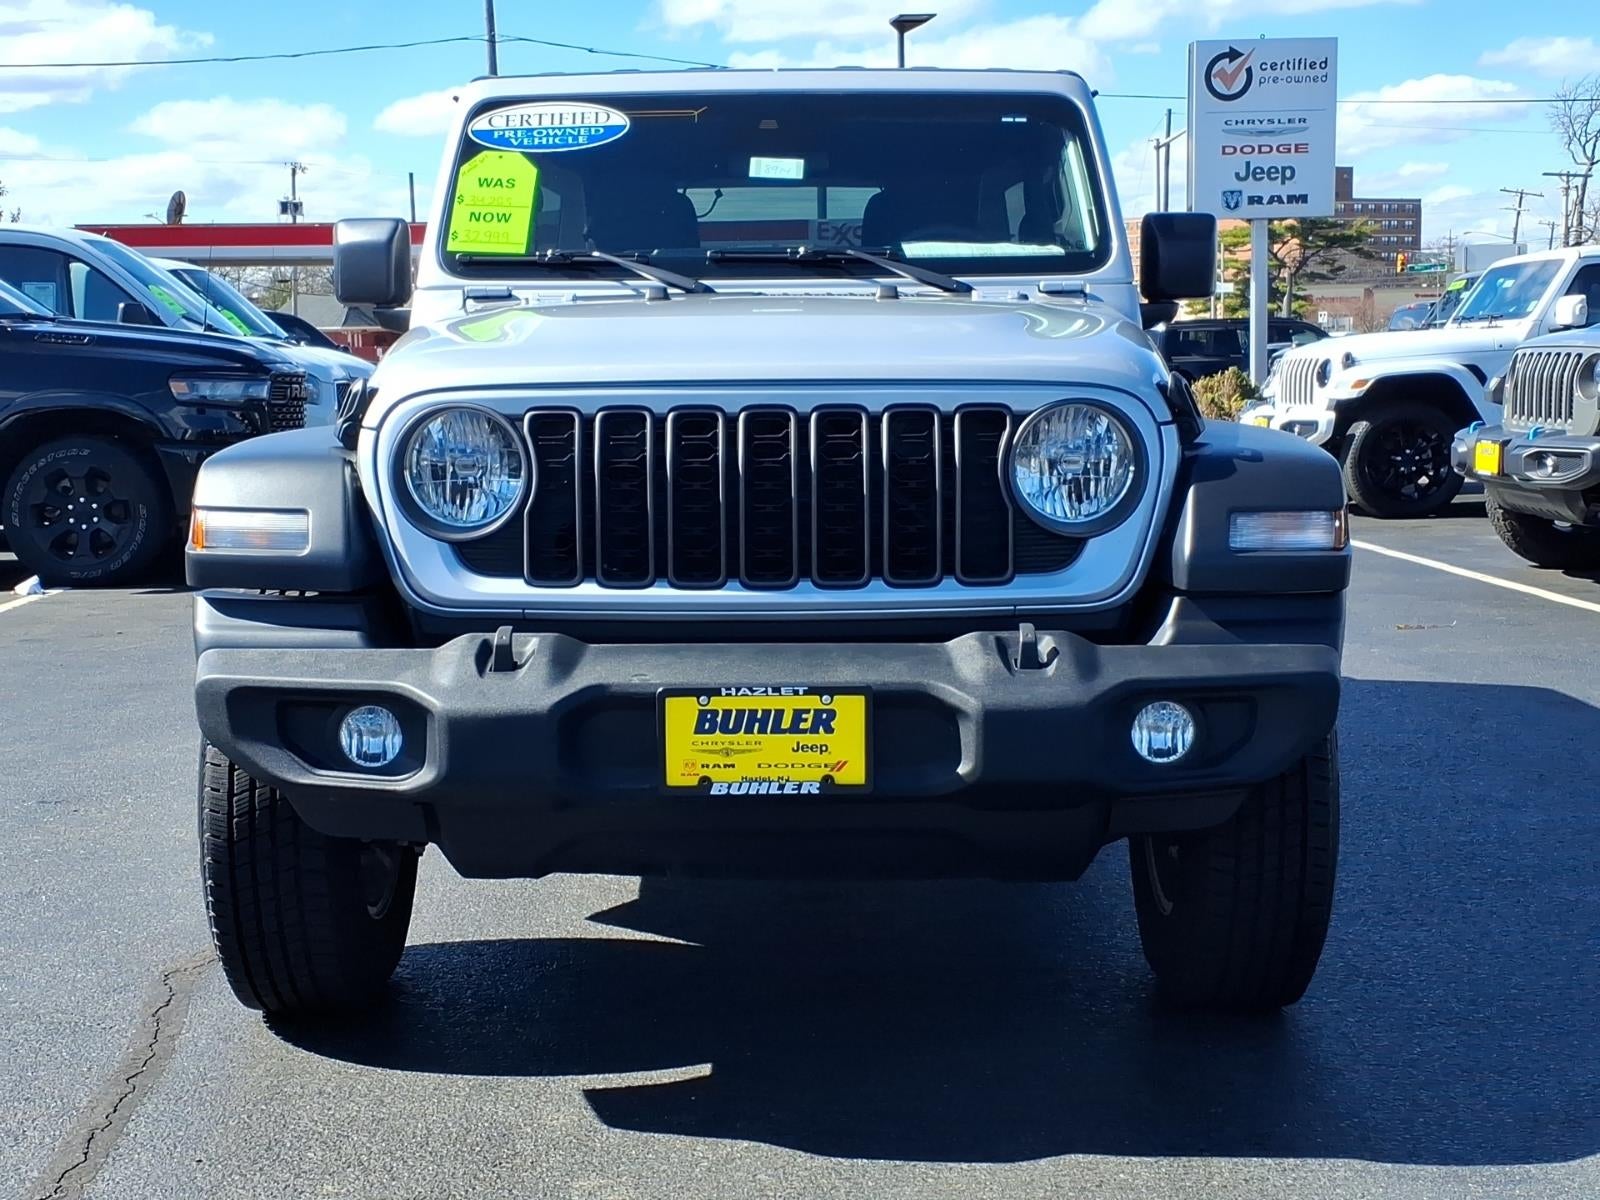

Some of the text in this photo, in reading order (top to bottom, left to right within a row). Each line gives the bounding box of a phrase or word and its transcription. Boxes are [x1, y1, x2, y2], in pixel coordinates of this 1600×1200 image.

[1260, 57, 1328, 72] certified
[1258, 72, 1328, 87] pre-owned
[488, 111, 611, 128] CERTIFIED
[1224, 118, 1308, 126] CHRYSLER
[493, 127, 605, 139] PRE-OWNED
[510, 135, 588, 146] VEHICLE
[1221, 143, 1309, 155] DODGE
[1234, 161, 1296, 185] Jeep
[478, 177, 516, 189] WAS
[1247, 193, 1309, 206] RAM
[469, 211, 512, 223] NOW
[721, 687, 808, 696] HAZLET
[693, 708, 837, 735] BUHLER
[791, 741, 829, 755] Jeep
[710, 782, 820, 795] BUHLER
